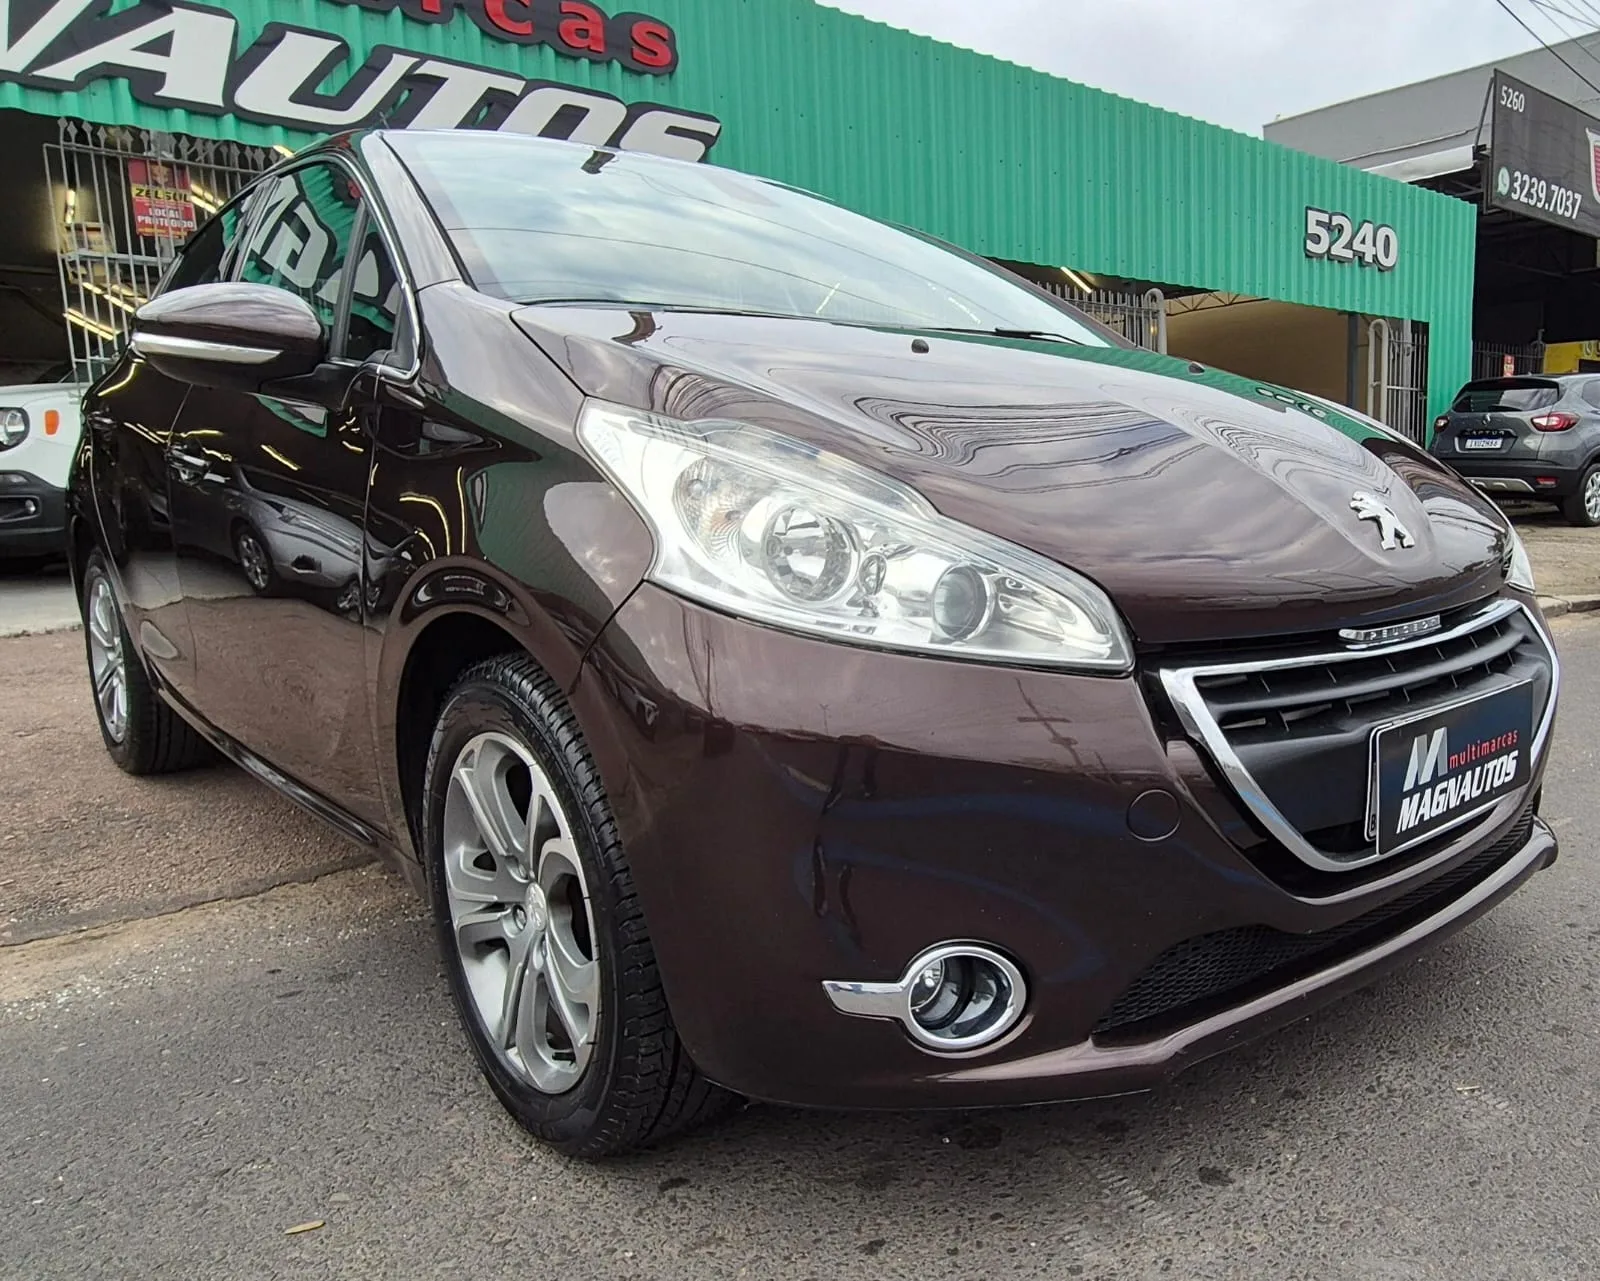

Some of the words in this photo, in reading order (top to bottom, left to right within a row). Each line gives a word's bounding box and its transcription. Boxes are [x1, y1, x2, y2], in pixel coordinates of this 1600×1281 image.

[1500, 85, 1525, 113] 5260
[148, 207, 180, 219] LOCAL
[1511, 170, 1583, 220] 3239.7037
[1305, 207, 1398, 269] 5240
[1449, 729, 1518, 769] multimarcas
[1396, 749, 1519, 834] MAGNAUTOS
